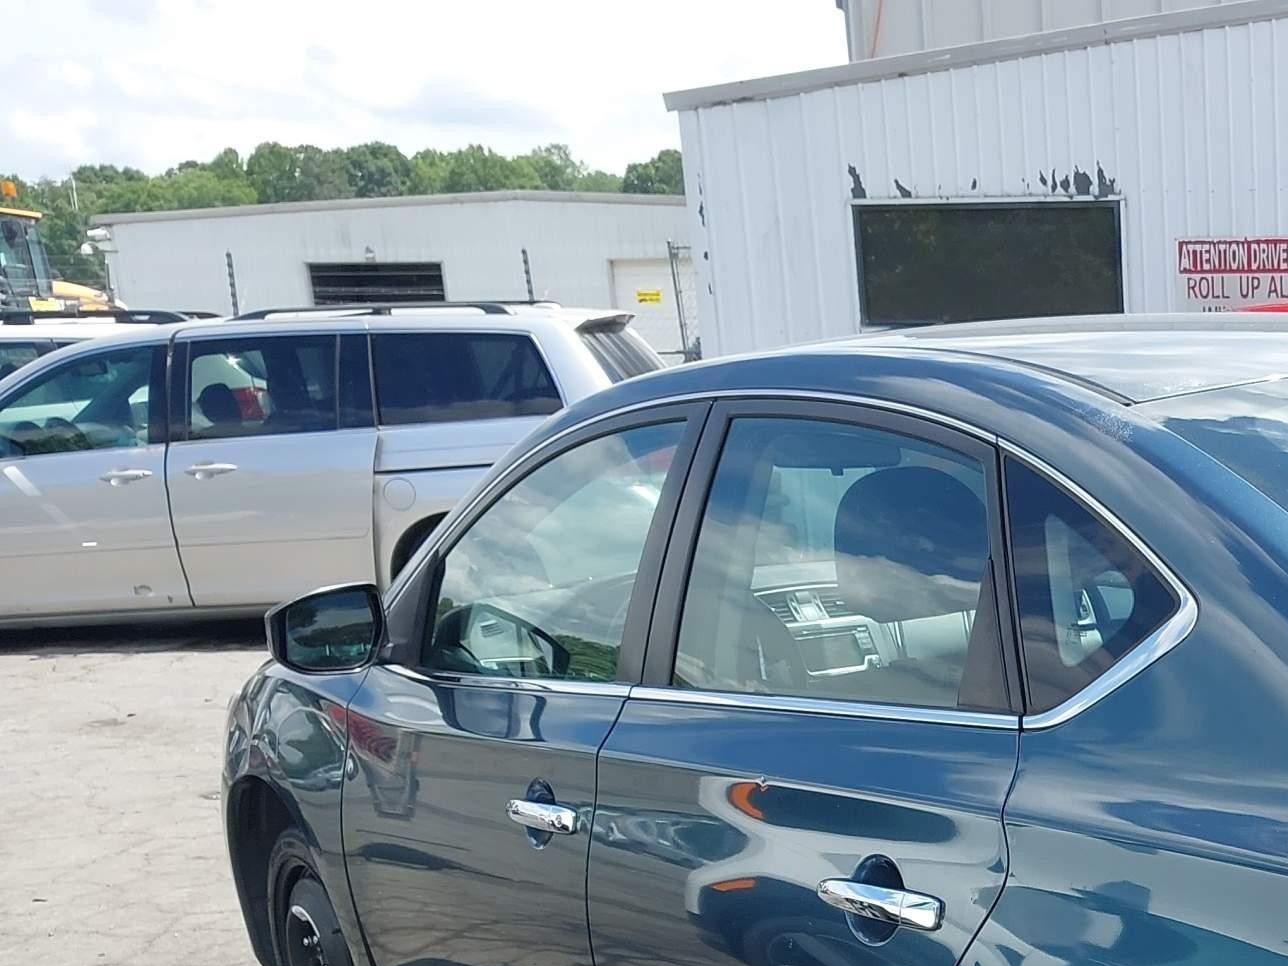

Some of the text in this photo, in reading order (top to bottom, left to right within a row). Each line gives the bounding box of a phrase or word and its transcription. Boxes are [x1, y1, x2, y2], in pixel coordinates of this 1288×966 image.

[1180, 242, 1247, 271] ATTENTION
[1187, 276, 1230, 299] ROLL
[1239, 276, 1260, 299] UP
